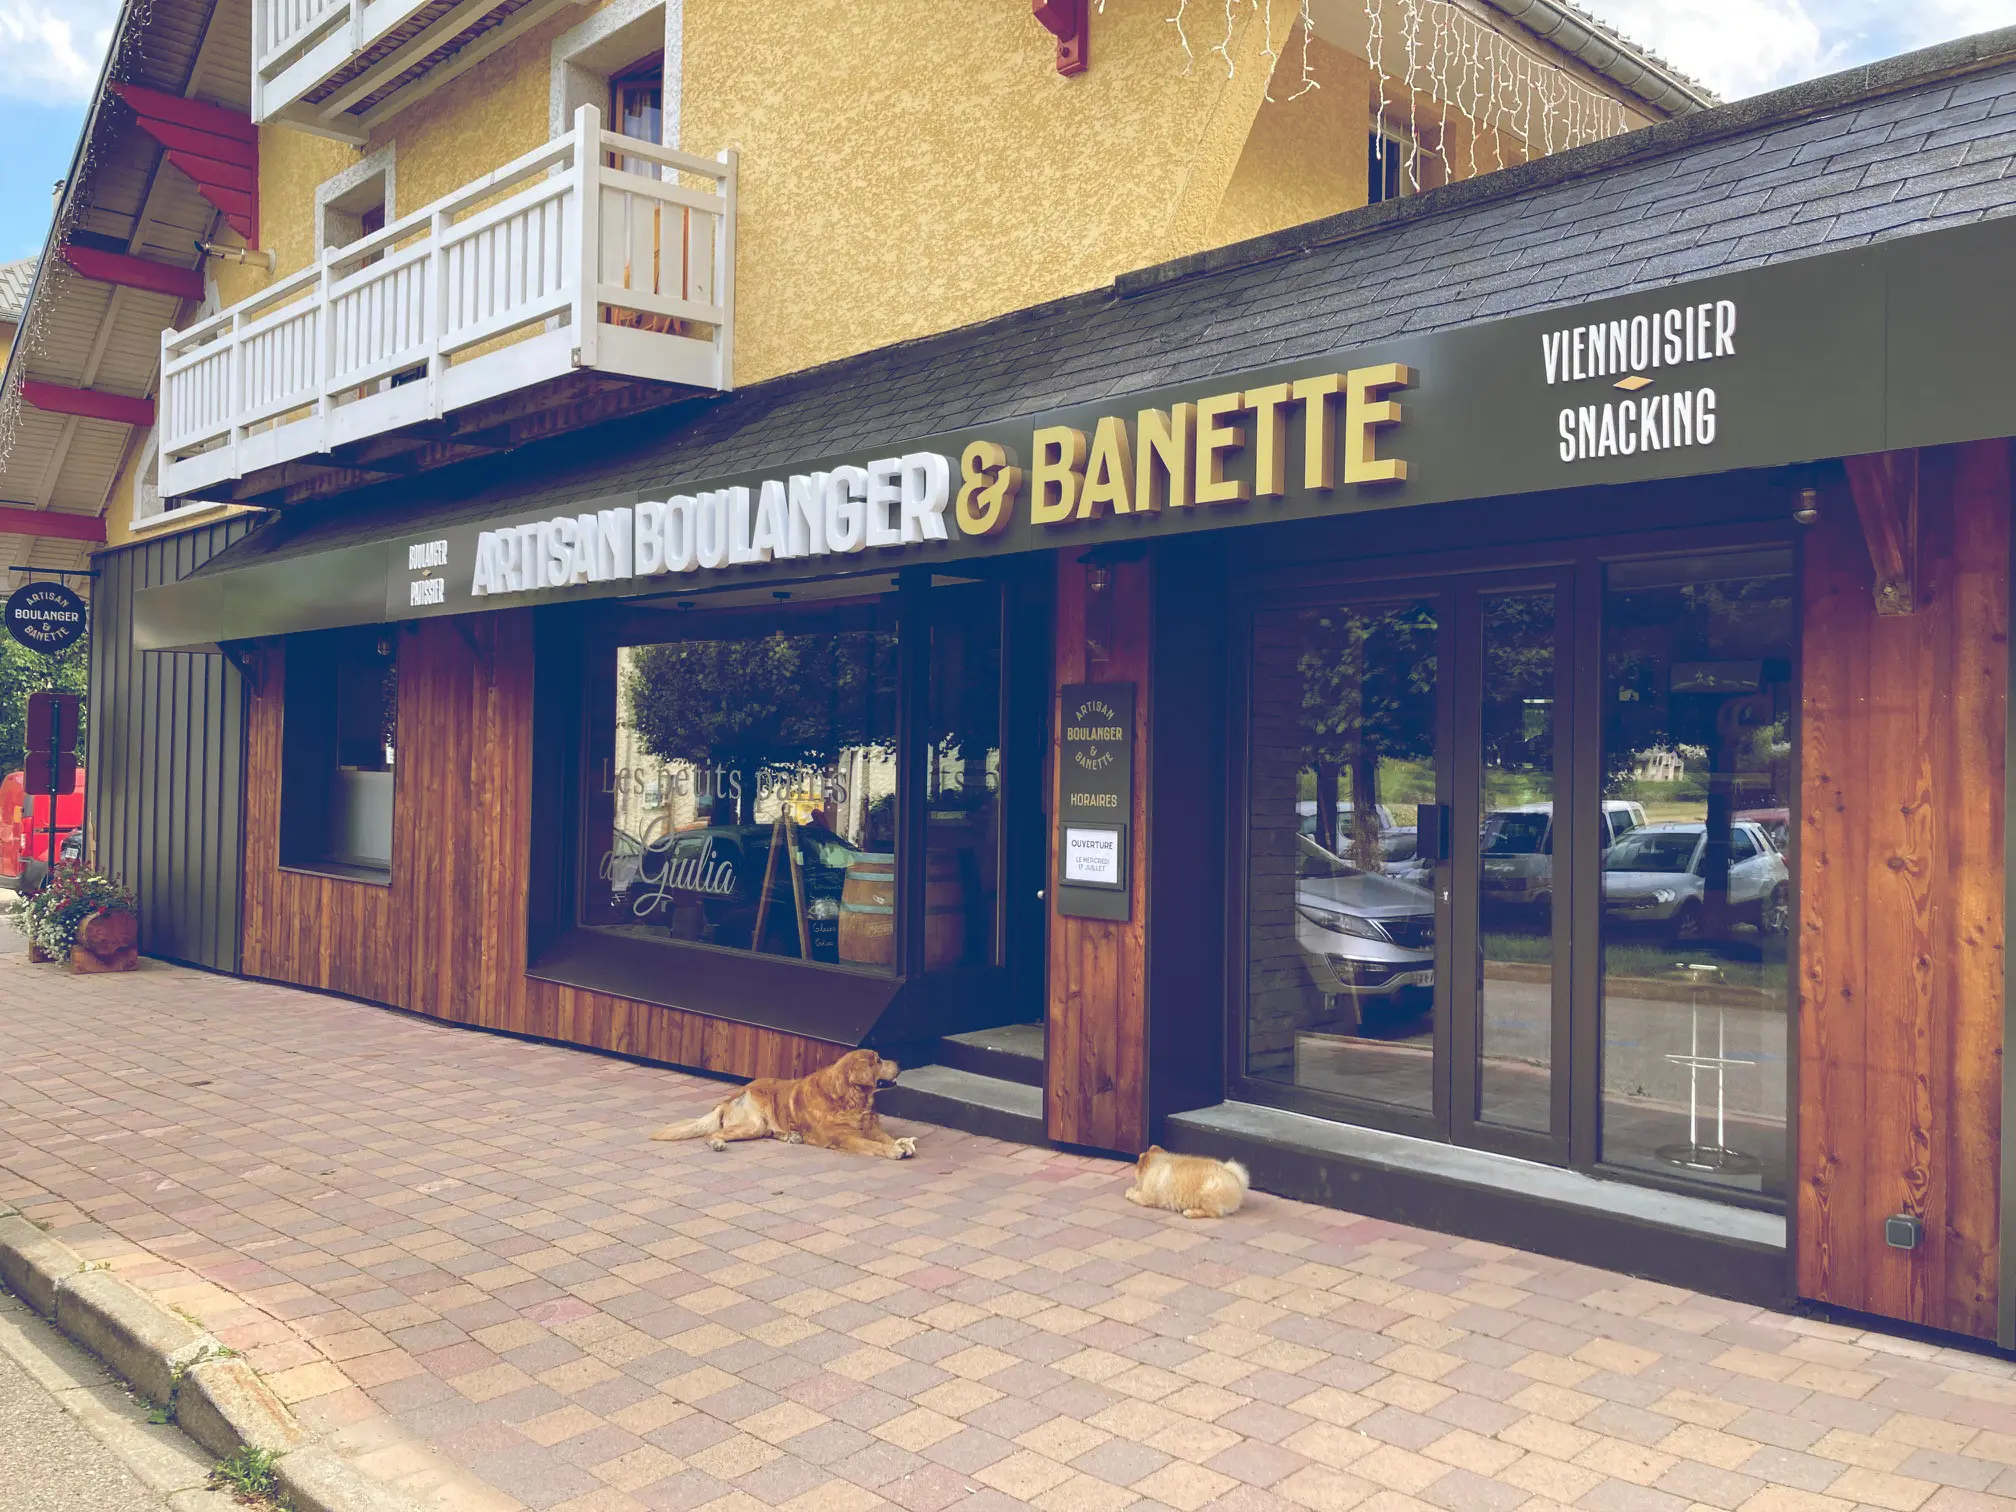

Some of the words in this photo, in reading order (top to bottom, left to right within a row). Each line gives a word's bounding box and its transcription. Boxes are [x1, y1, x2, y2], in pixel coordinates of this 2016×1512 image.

[1542, 300, 1736, 384] VIENNOISIER
[1559, 388, 1716, 462] SNACKING
[472, 507, 633, 596] ARTISAN
[634, 452, 950, 576] BOULANGER
[956, 440, 1022, 537] &
[1031, 363, 1409, 525] BANETTE
[409, 540, 447, 570] BOULANGER
[26, 592, 69, 608] ARTISAN
[15, 608, 79, 622] BOULANGER
[24, 625, 70, 642] BANETTE
[42, 622, 51, 632] &
[1075, 701, 1115, 721] ARTISAN
[1067, 727, 1123, 741] BOULANGER
[1090, 745, 1098, 757] &
[1075, 751, 1114, 770] BANETTE
[602, 757, 645, 795] Les
[657, 758, 742, 806] petits
[756, 760, 848, 813] pains
[1070, 793, 1118, 807] HORAIRES
[1071, 839, 1114, 850] OUVERTURE
[633, 815, 737, 916] Giulia
[1083, 857, 1110, 865] MERCREDI
[1085, 864, 1106, 872] JUILLET
